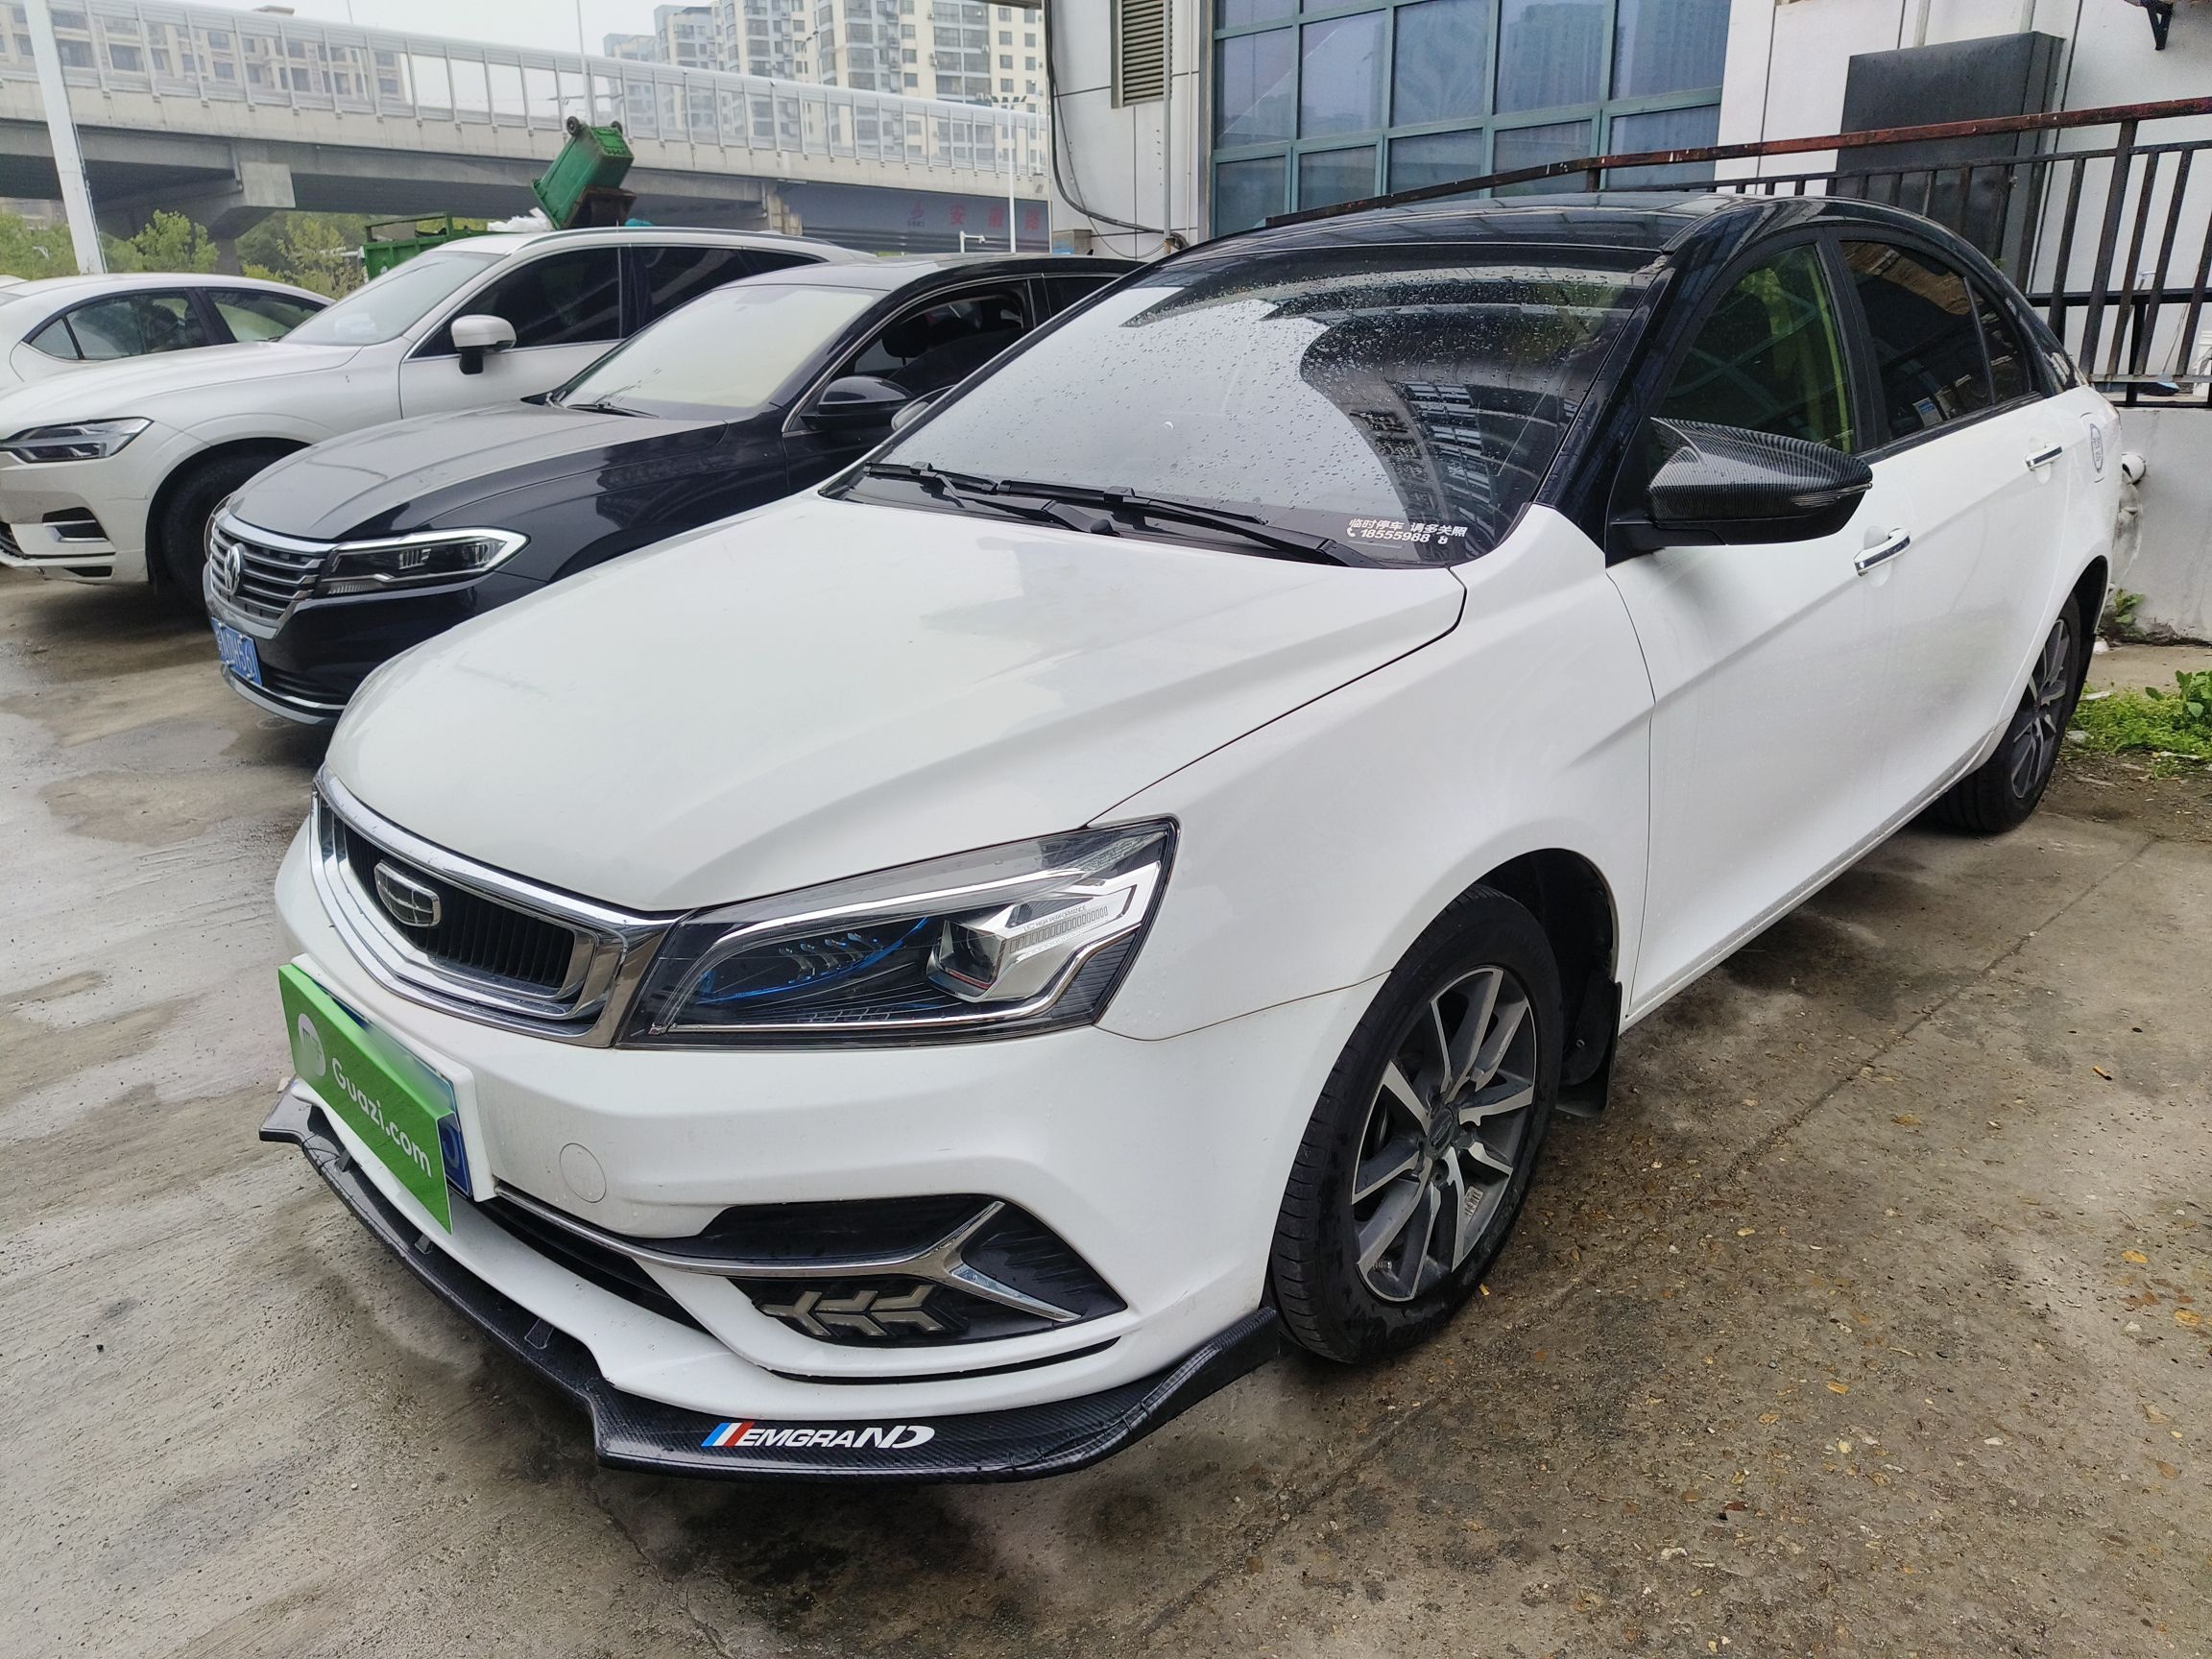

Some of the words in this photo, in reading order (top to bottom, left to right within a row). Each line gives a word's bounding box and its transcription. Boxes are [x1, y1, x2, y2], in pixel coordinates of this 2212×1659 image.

[1349, 518, 1405, 531] 临时停车
[1410, 522, 1468, 537] 请多关照
[332, 1058, 432, 1178] Guazi.com
[734, 1425, 935, 1449] EMGRAND
